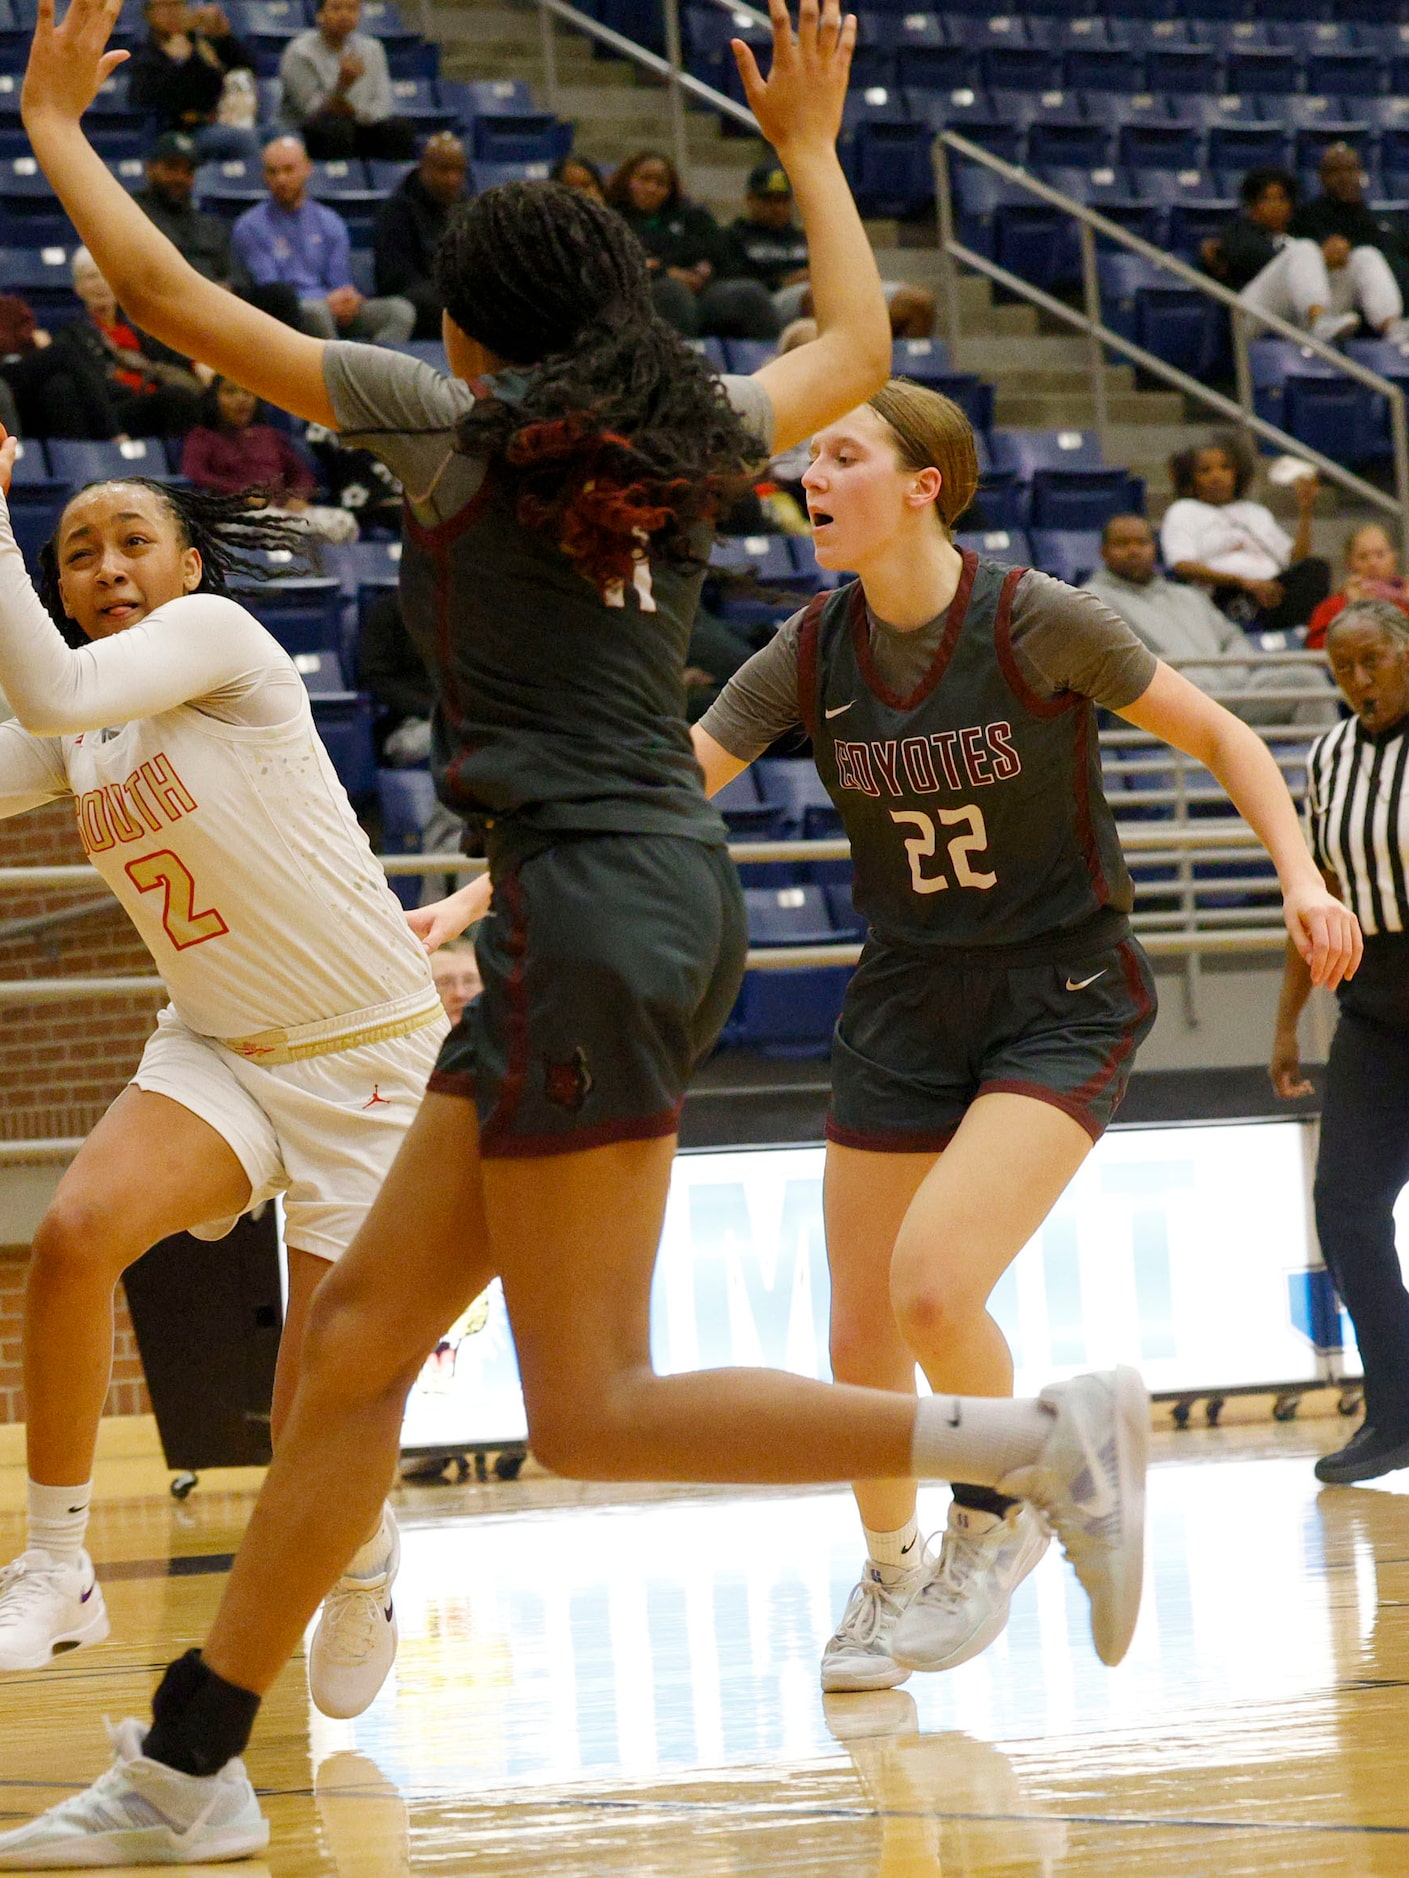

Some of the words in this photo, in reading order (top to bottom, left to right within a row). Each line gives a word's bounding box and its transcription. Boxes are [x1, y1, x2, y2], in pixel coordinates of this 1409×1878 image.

[75, 752, 198, 856] OUTH
[833, 720, 1022, 797] COYOTES
[888, 803, 998, 895] 22
[124, 848, 230, 951] 2
